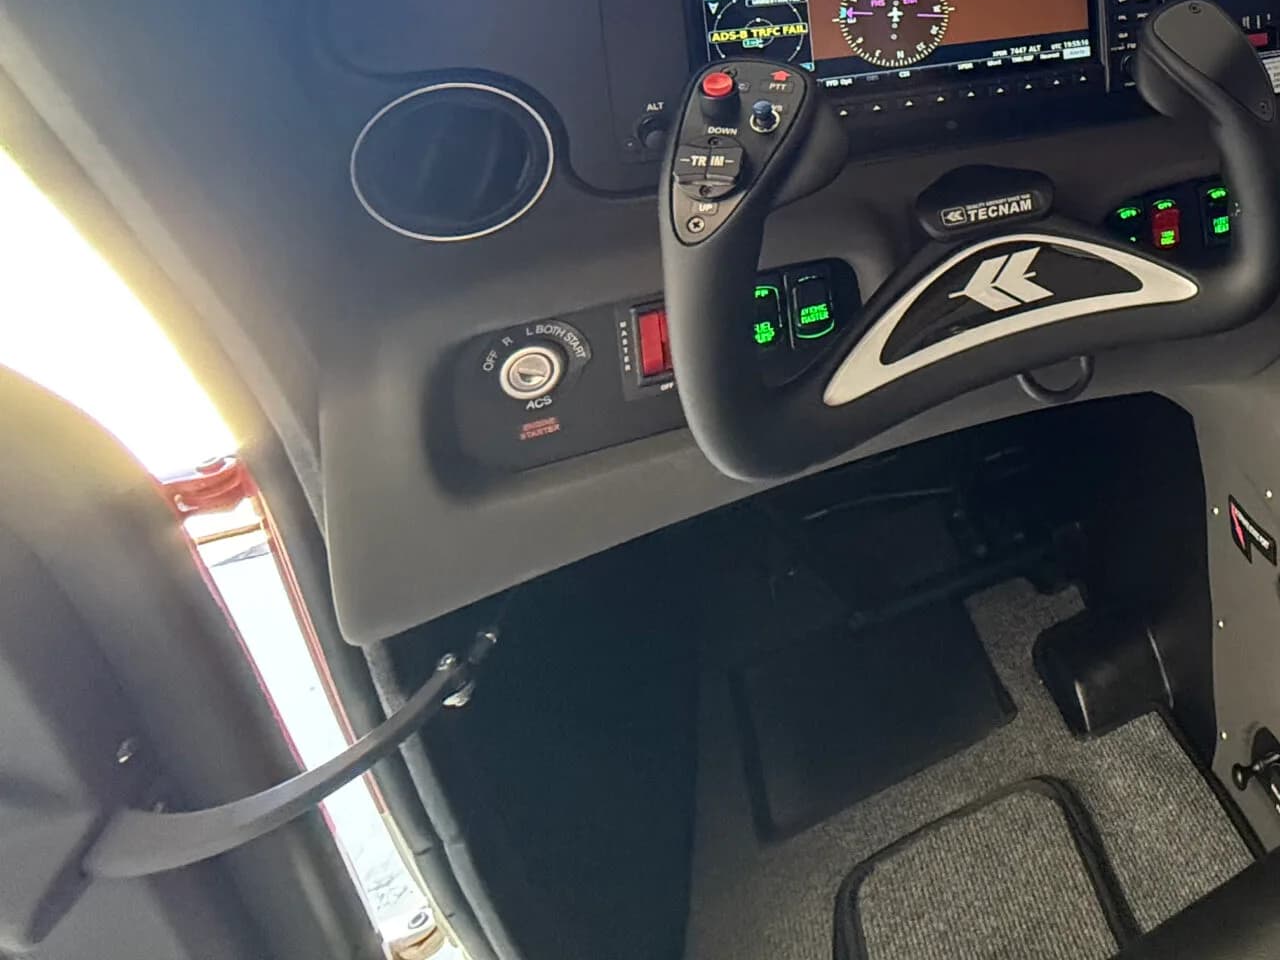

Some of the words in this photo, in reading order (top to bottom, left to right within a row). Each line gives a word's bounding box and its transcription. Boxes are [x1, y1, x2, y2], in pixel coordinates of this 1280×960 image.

[712, 30, 748, 42] ADS-B
[751, 26, 781, 38] TRFC
[782, 24, 805, 35] FAIL
[1028, 44, 1041, 53] ALT
[769, 82, 787, 91] PTT
[646, 102, 665, 112] ALT
[707, 126, 738, 136] DOWN
[699, 203, 713, 212] UP
[967, 199, 1033, 222] TECNAM
[526, 328, 534, 336] L
[535, 324, 566, 339] BOTH
[502, 335, 514, 347] R
[564, 332, 587, 359] START
[619, 321, 632, 372] MASTER
[483, 349, 499, 372] OFF
[660, 382, 675, 391] OFF
[525, 395, 553, 410] ACS
